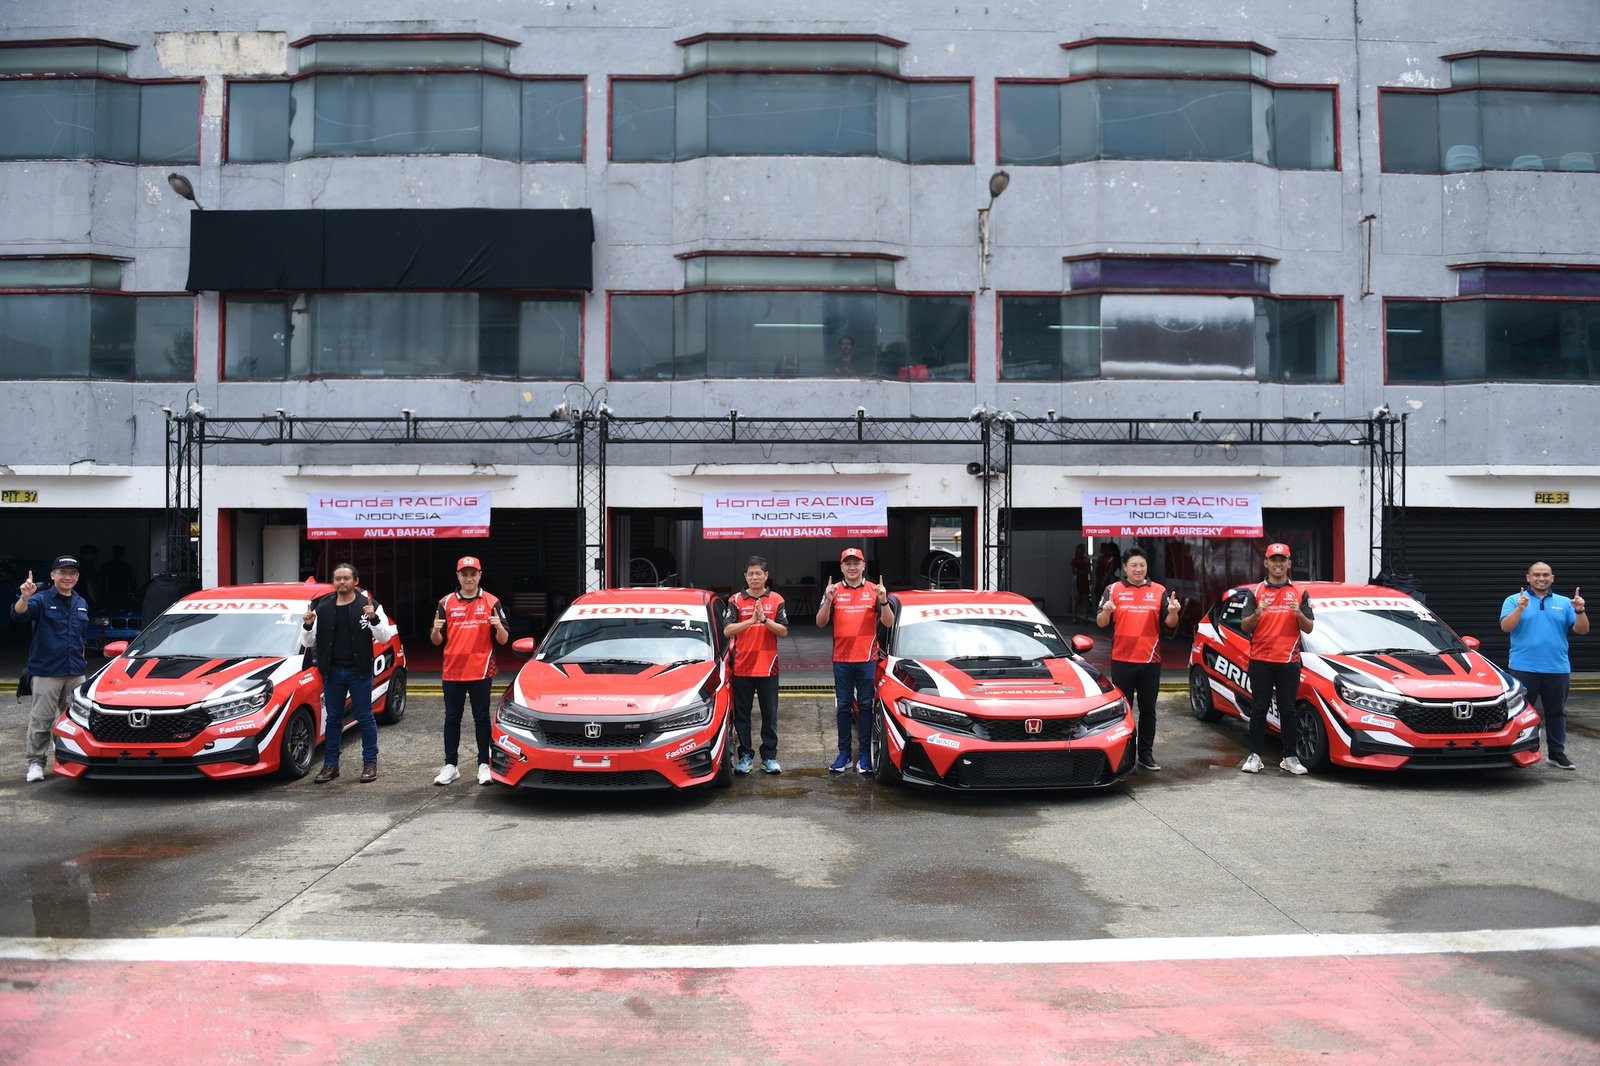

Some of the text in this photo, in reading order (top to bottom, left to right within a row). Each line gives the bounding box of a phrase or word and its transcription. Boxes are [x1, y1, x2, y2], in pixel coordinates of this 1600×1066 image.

[1, 490, 38, 503] PIT 37
[1094, 496, 1249, 507] Honda RACING
[320, 496, 478, 508] Honda RACING
[716, 496, 874, 508] Honda RACING
[355, 512, 441, 521] INDONESIA
[751, 511, 838, 521] INDONESIA
[1129, 511, 1214, 519] INDONESIA
[364, 528, 435, 537] AVILA BAHAR
[760, 528, 832, 537] ALVIN BAHAR
[1120, 527, 1134, 535] M.
[1136, 527, 1170, 535] ANDRI
[183, 602, 289, 610] HONDA
[1310, 599, 1412, 609] HONDA
[578, 607, 695, 616] HONDA
[920, 607, 1029, 617] HONDA
[1033, 632, 1057, 640] ALVIN
[219, 723, 256, 734] Fastron
[1369, 718, 1394, 729] WINCOS
[935, 739, 959, 748] WINCOS
[665, 742, 697, 760] Fastron
